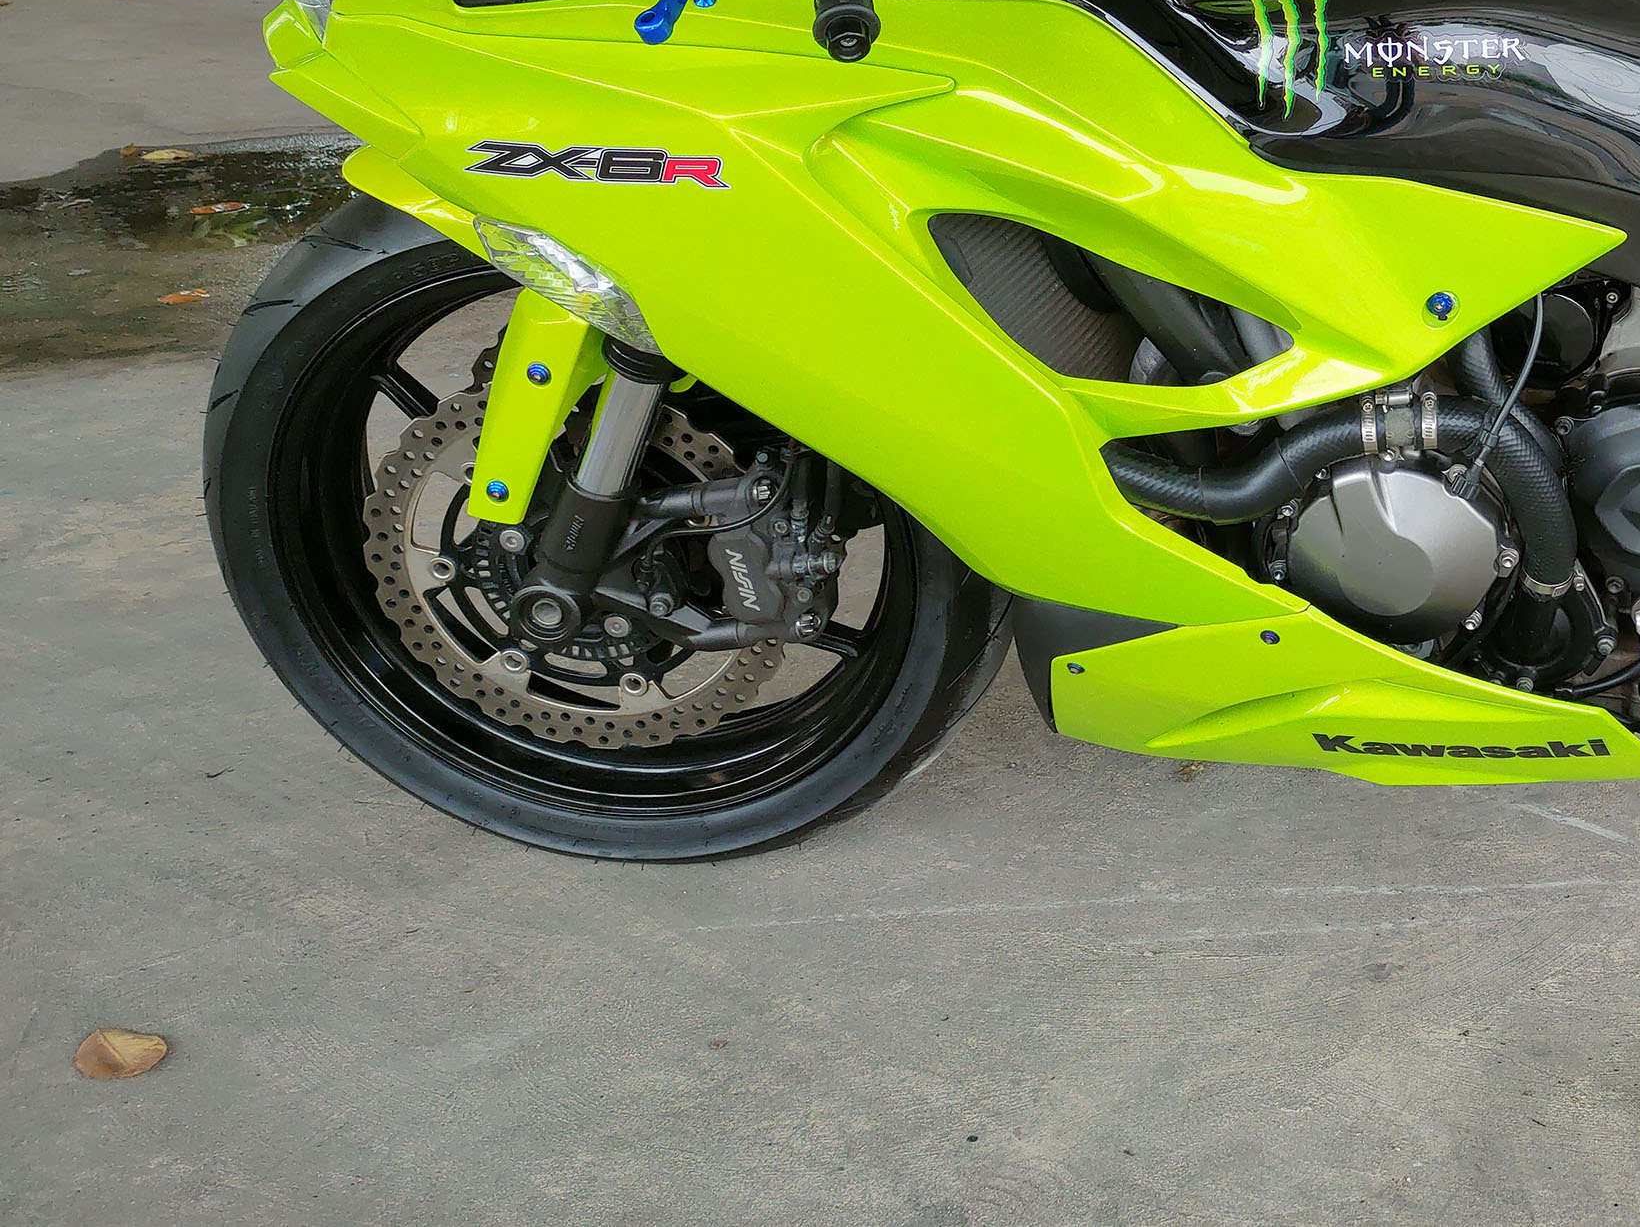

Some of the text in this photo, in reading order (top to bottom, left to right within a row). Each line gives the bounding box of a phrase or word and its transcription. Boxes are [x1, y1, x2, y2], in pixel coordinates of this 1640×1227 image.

[1344, 36, 1526, 67] MONSTER
[1372, 64, 1501, 78] ENERGY
[463, 140, 732, 190] ZX-6R
[724, 548, 761, 612] NISSIN
[1311, 732, 1612, 759] Kawasaki
